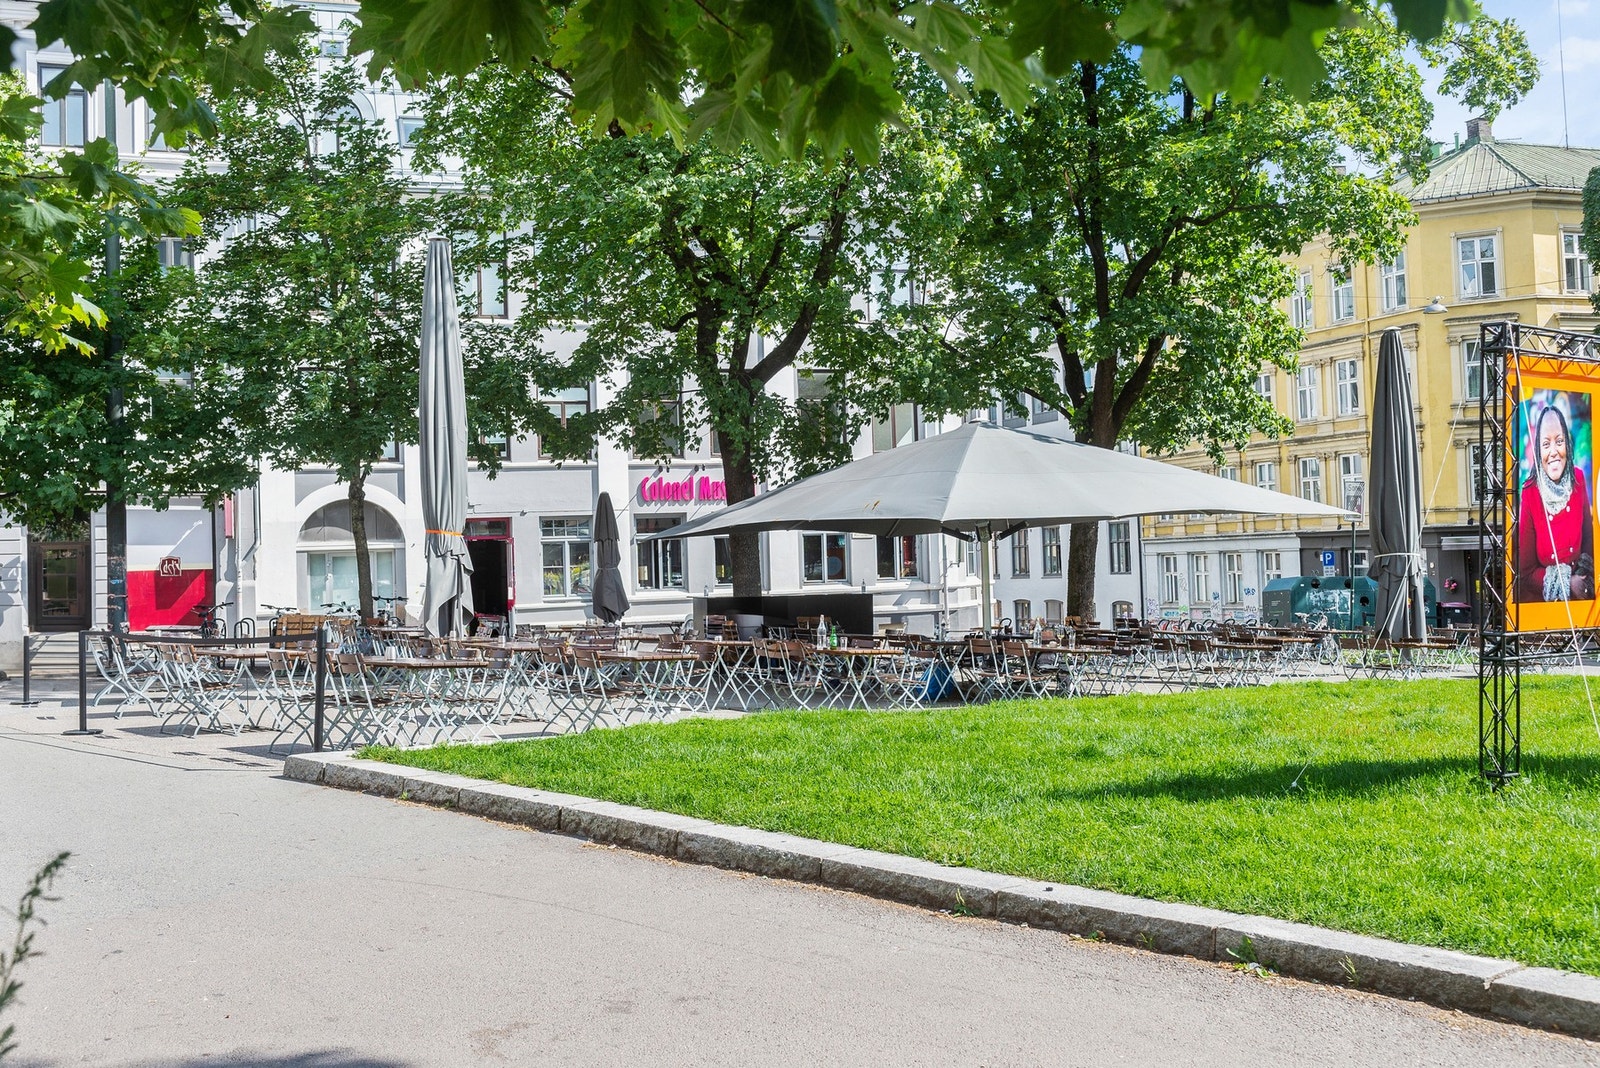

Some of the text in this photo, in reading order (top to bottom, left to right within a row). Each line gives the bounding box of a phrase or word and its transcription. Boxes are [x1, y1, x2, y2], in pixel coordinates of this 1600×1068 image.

[641, 475, 727, 502] Colonel Mus
[1325, 553, 1332, 565] P
